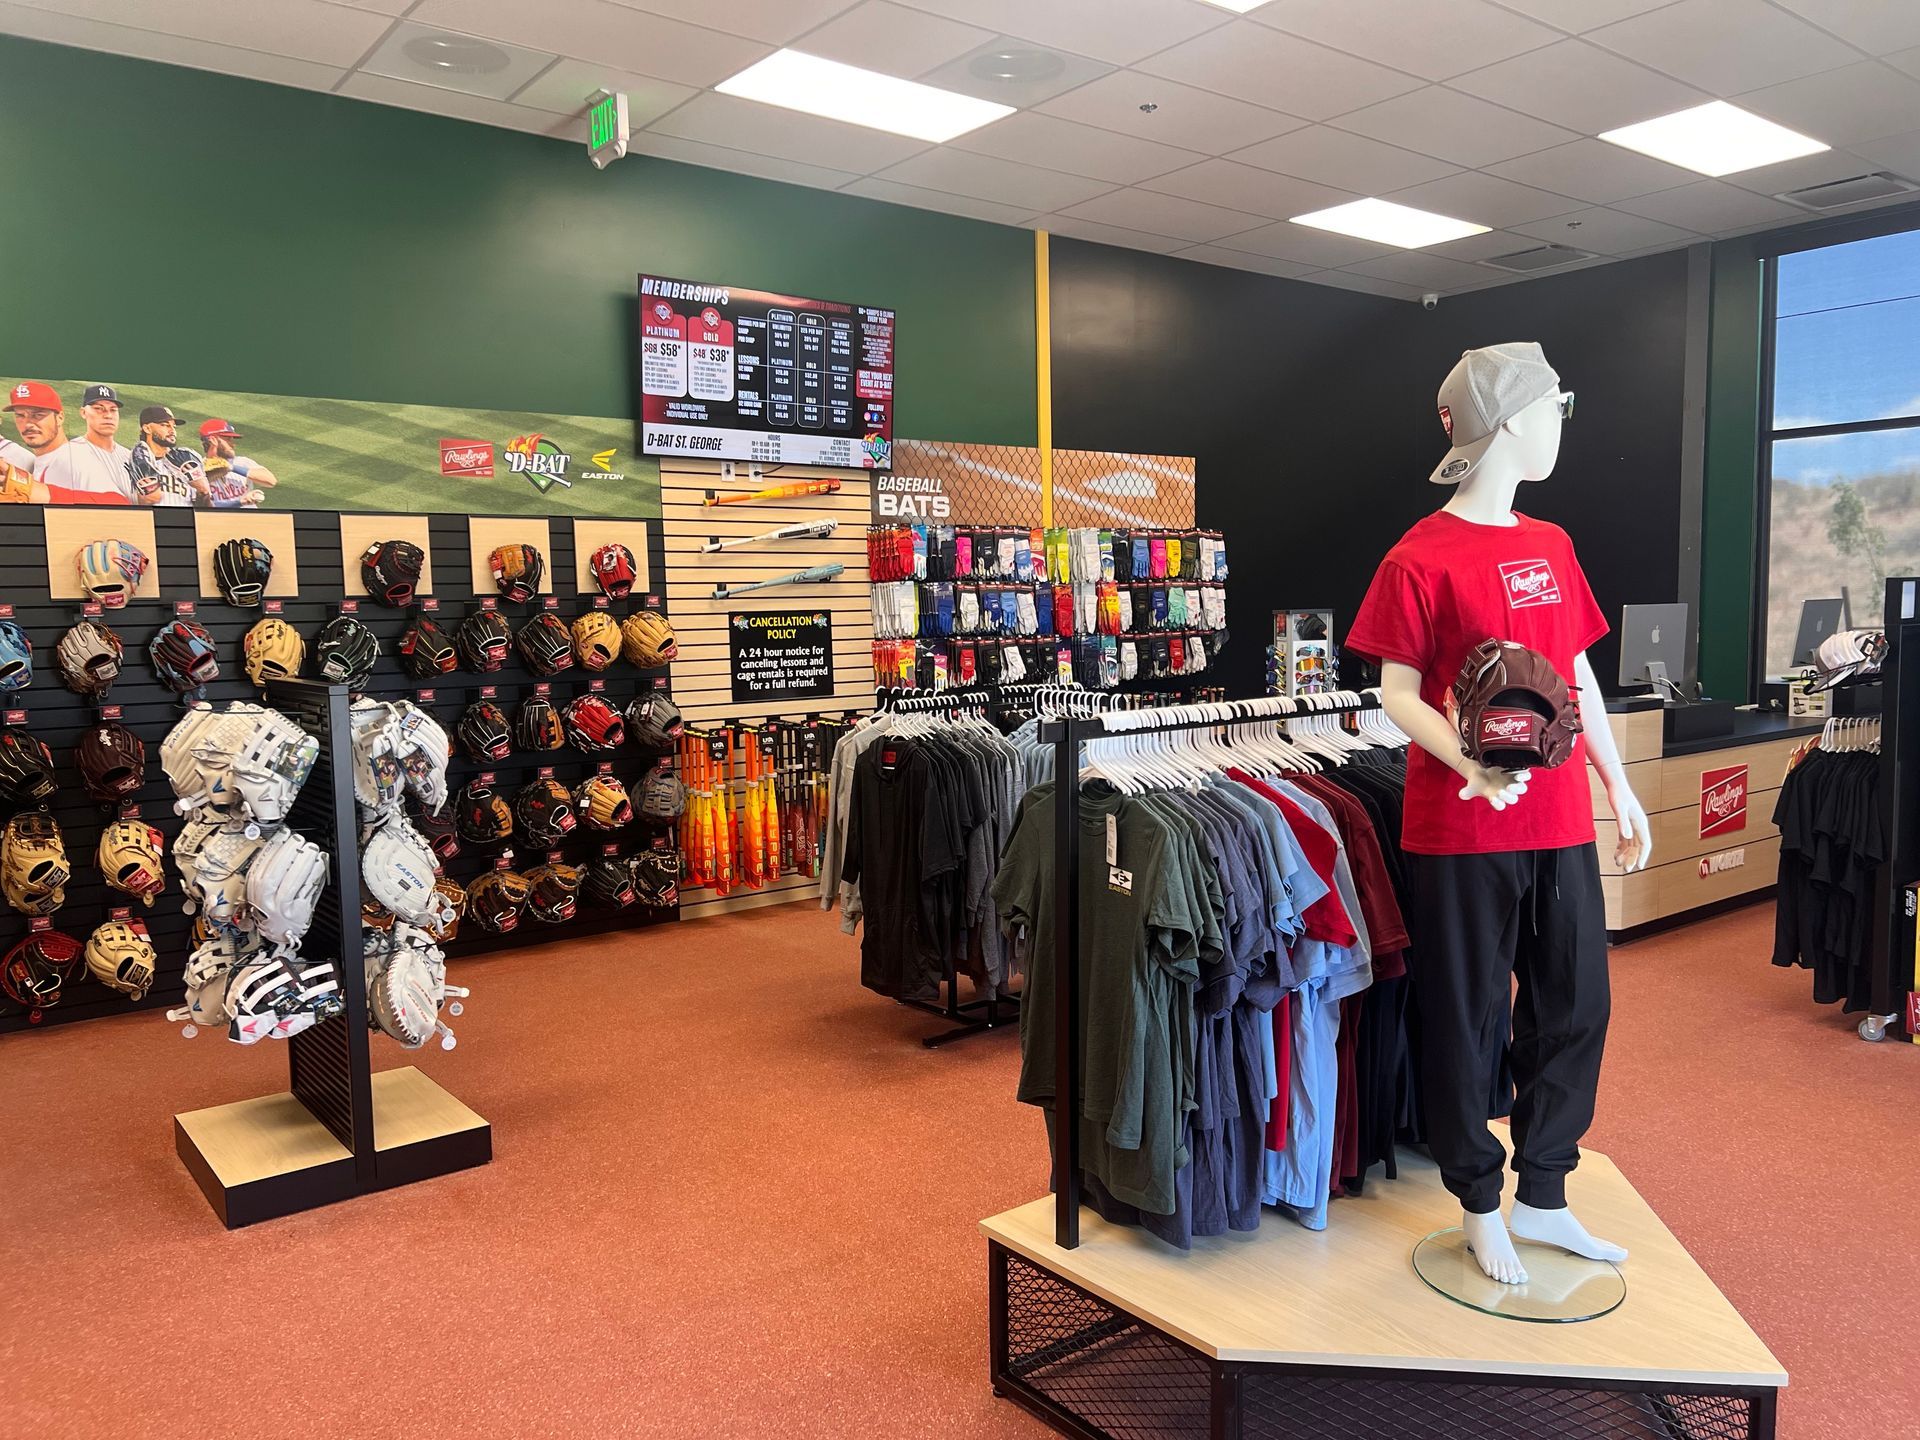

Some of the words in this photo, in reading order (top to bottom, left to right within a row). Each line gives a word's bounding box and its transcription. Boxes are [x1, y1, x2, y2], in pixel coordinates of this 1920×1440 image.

[591, 97, 614, 150] EXIT
[641, 278, 729, 305] MEMBERSHIPS
[646, 326, 680, 338] PLATINUM
[703, 332, 719, 342] GOLD
[738, 354, 760, 365] LESSONS
[738, 390, 759, 400] RENTALS
[647, 432, 674, 448] D-BAT
[675, 435, 687, 449] ST.
[689, 436, 723, 451] GEORGE
[445, 449, 489, 467] Rawlings
[510, 452, 570, 474] D-BAT
[581, 472, 624, 481] EASTON
[877, 475, 943, 493] BASEBALL
[878, 493, 951, 518] BATS
[810, 523, 836, 534] ICON
[1511, 570, 1550, 593] Rawlings
[750, 616, 812, 627] CANCELLATION
[767, 629, 796, 639] POLICY
[739, 648, 747, 658] A
[749, 647, 761, 658] 24
[763, 647, 783, 657] hour
[785, 646, 810, 656] notice
[812, 645, 824, 655] for
[740, 659, 778, 669] canceling
[780, 658, 807, 667] lessons
[809, 656, 824, 666] and
[737, 672, 756, 681] cage
[758, 669, 785, 679] rentals
[787, 668, 793, 677] is
[795, 666, 828, 678] required
[749, 681, 763, 690] for
[772, 679, 786, 689] full
[788, 678, 817, 687] refund.
[1485, 718, 1529, 735] Rawlings
[1705, 783, 1744, 815] Rawlings
[1709, 849, 1744, 874] WORTH
[395, 863, 425, 890] EASTON
[1109, 884, 1131, 896] EASTON
